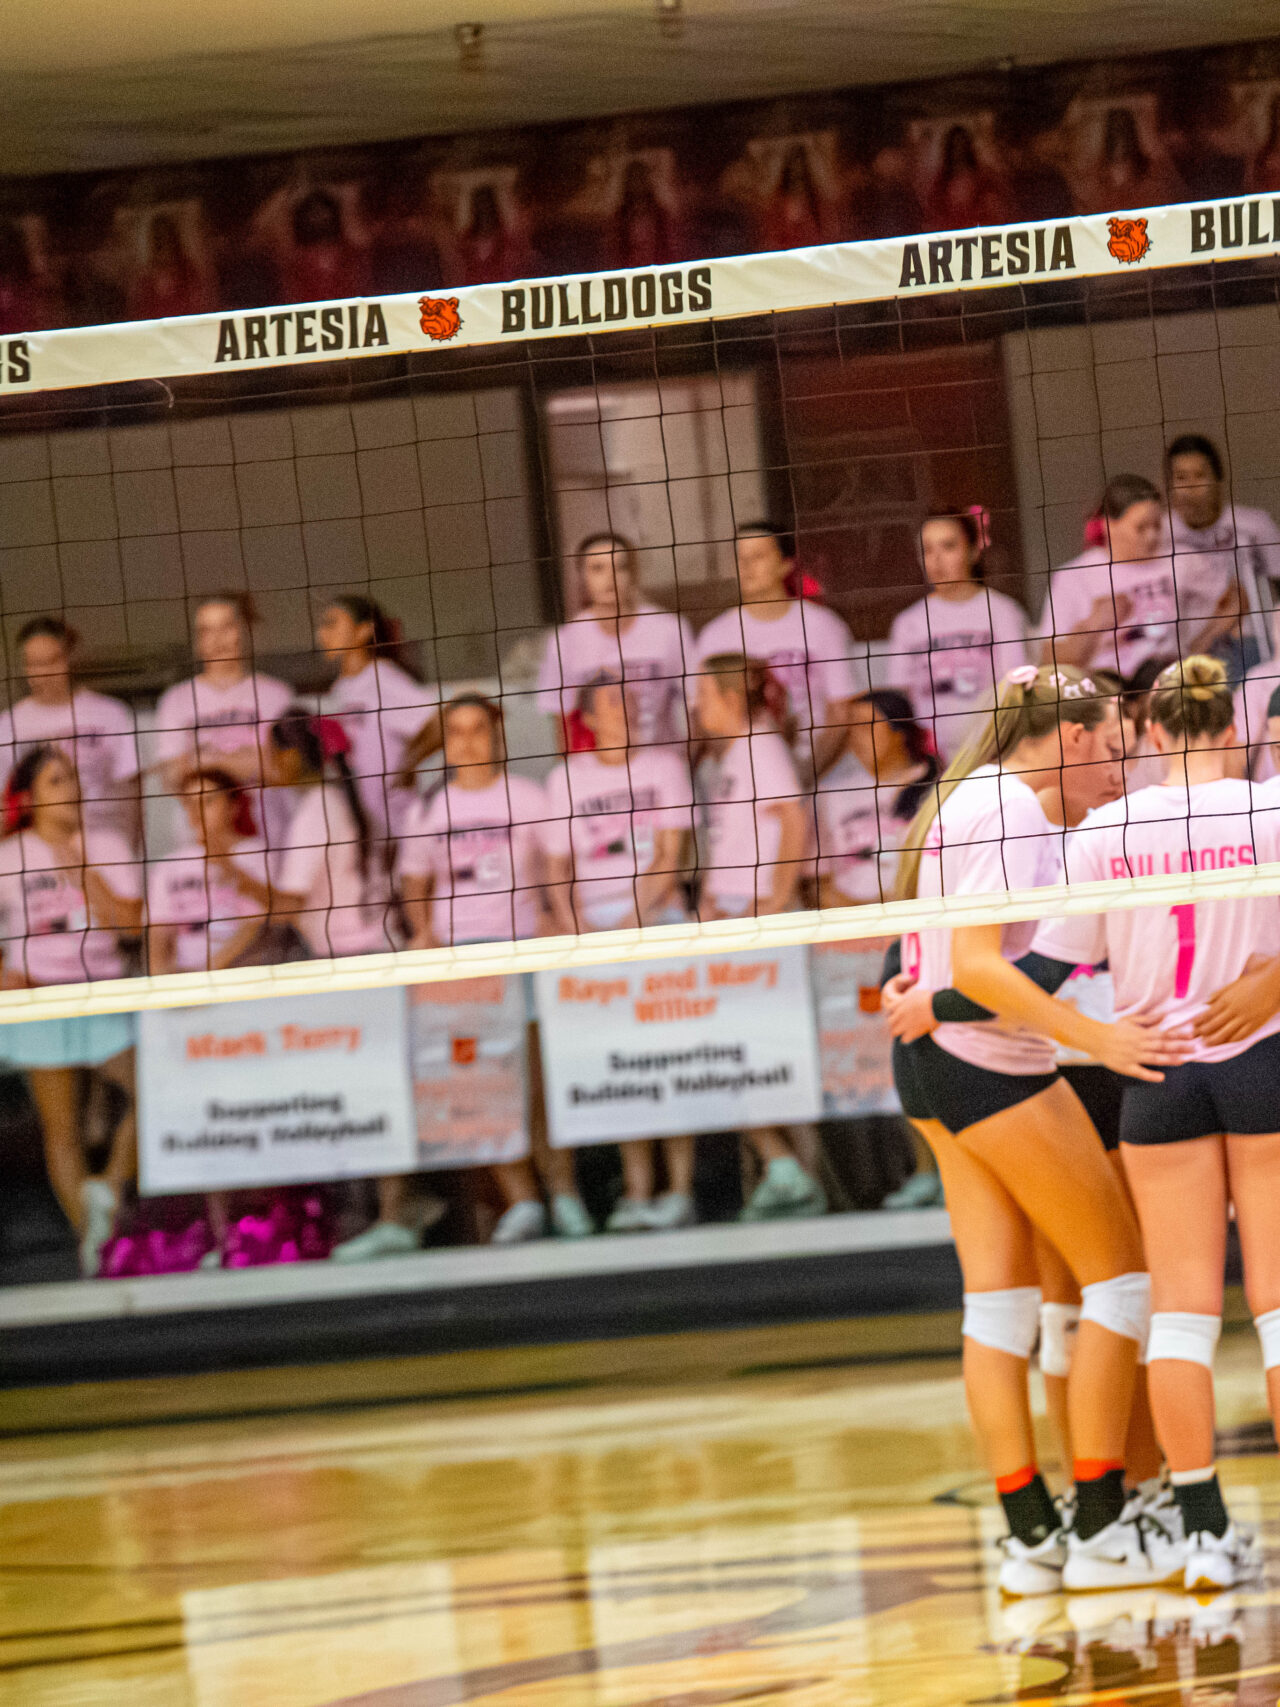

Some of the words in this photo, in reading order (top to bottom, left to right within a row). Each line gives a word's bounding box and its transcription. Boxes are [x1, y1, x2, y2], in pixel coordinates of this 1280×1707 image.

[898, 226, 1076, 288] ARTESIA
[215, 304, 389, 363] ARTESIA
[501, 267, 713, 334] BULLDOGS
[0, 339, 31, 384] S
[644, 967, 697, 995] and
[706, 960, 779, 988] Mary
[609, 1044, 747, 1074] Supporting
[569, 1082, 663, 1107] Bulldog
[674, 1063, 792, 1097] Volleyball
[207, 1093, 345, 1123] Supporting
